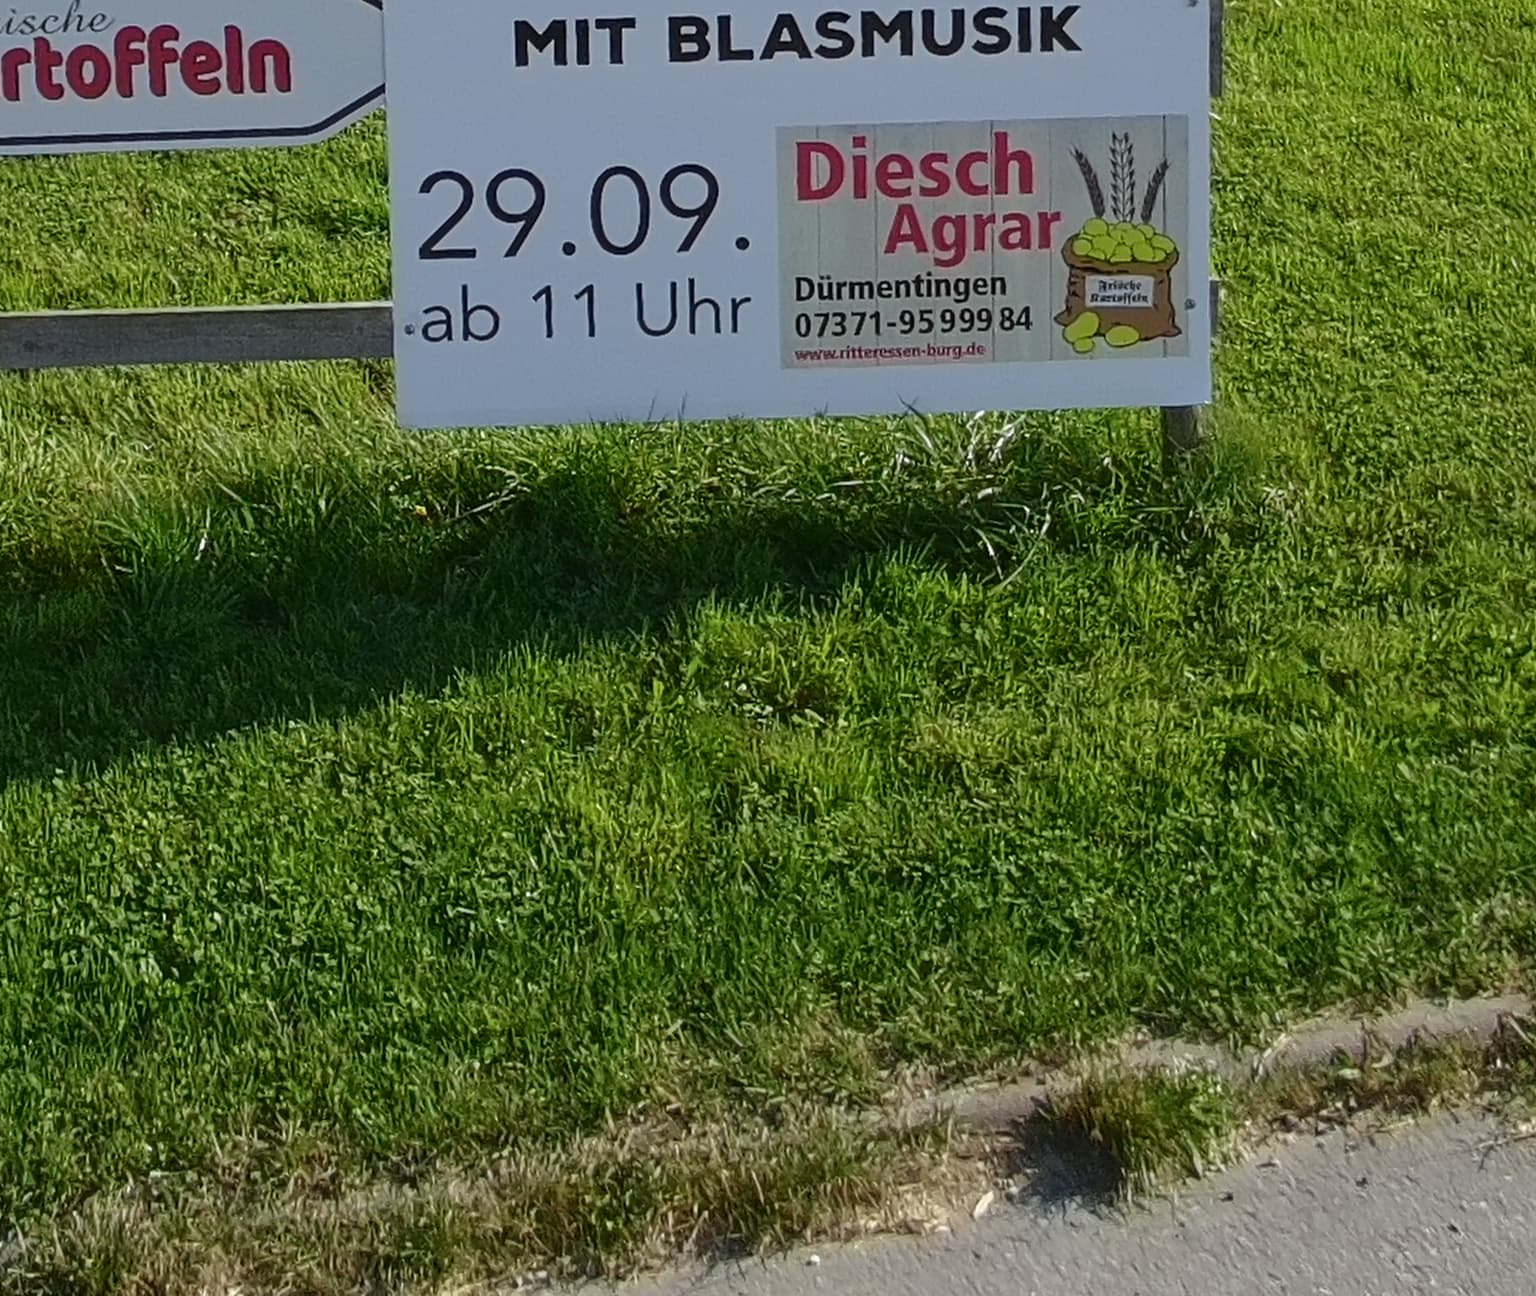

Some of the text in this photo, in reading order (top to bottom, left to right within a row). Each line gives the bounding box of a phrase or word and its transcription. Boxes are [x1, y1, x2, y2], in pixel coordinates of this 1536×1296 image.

[512, 4, 1082, 68] MIT BLASMUSIK
[795, 131, 1034, 202] Diesch
[417, 162, 751, 261] 29.09.
[883, 203, 1063, 268] Agrar
[420, 277, 753, 345] ab 11 Uhr
[794, 271, 1008, 304] Dürmentingen
[793, 342, 986, 363] www.ritteressen-burg.de
